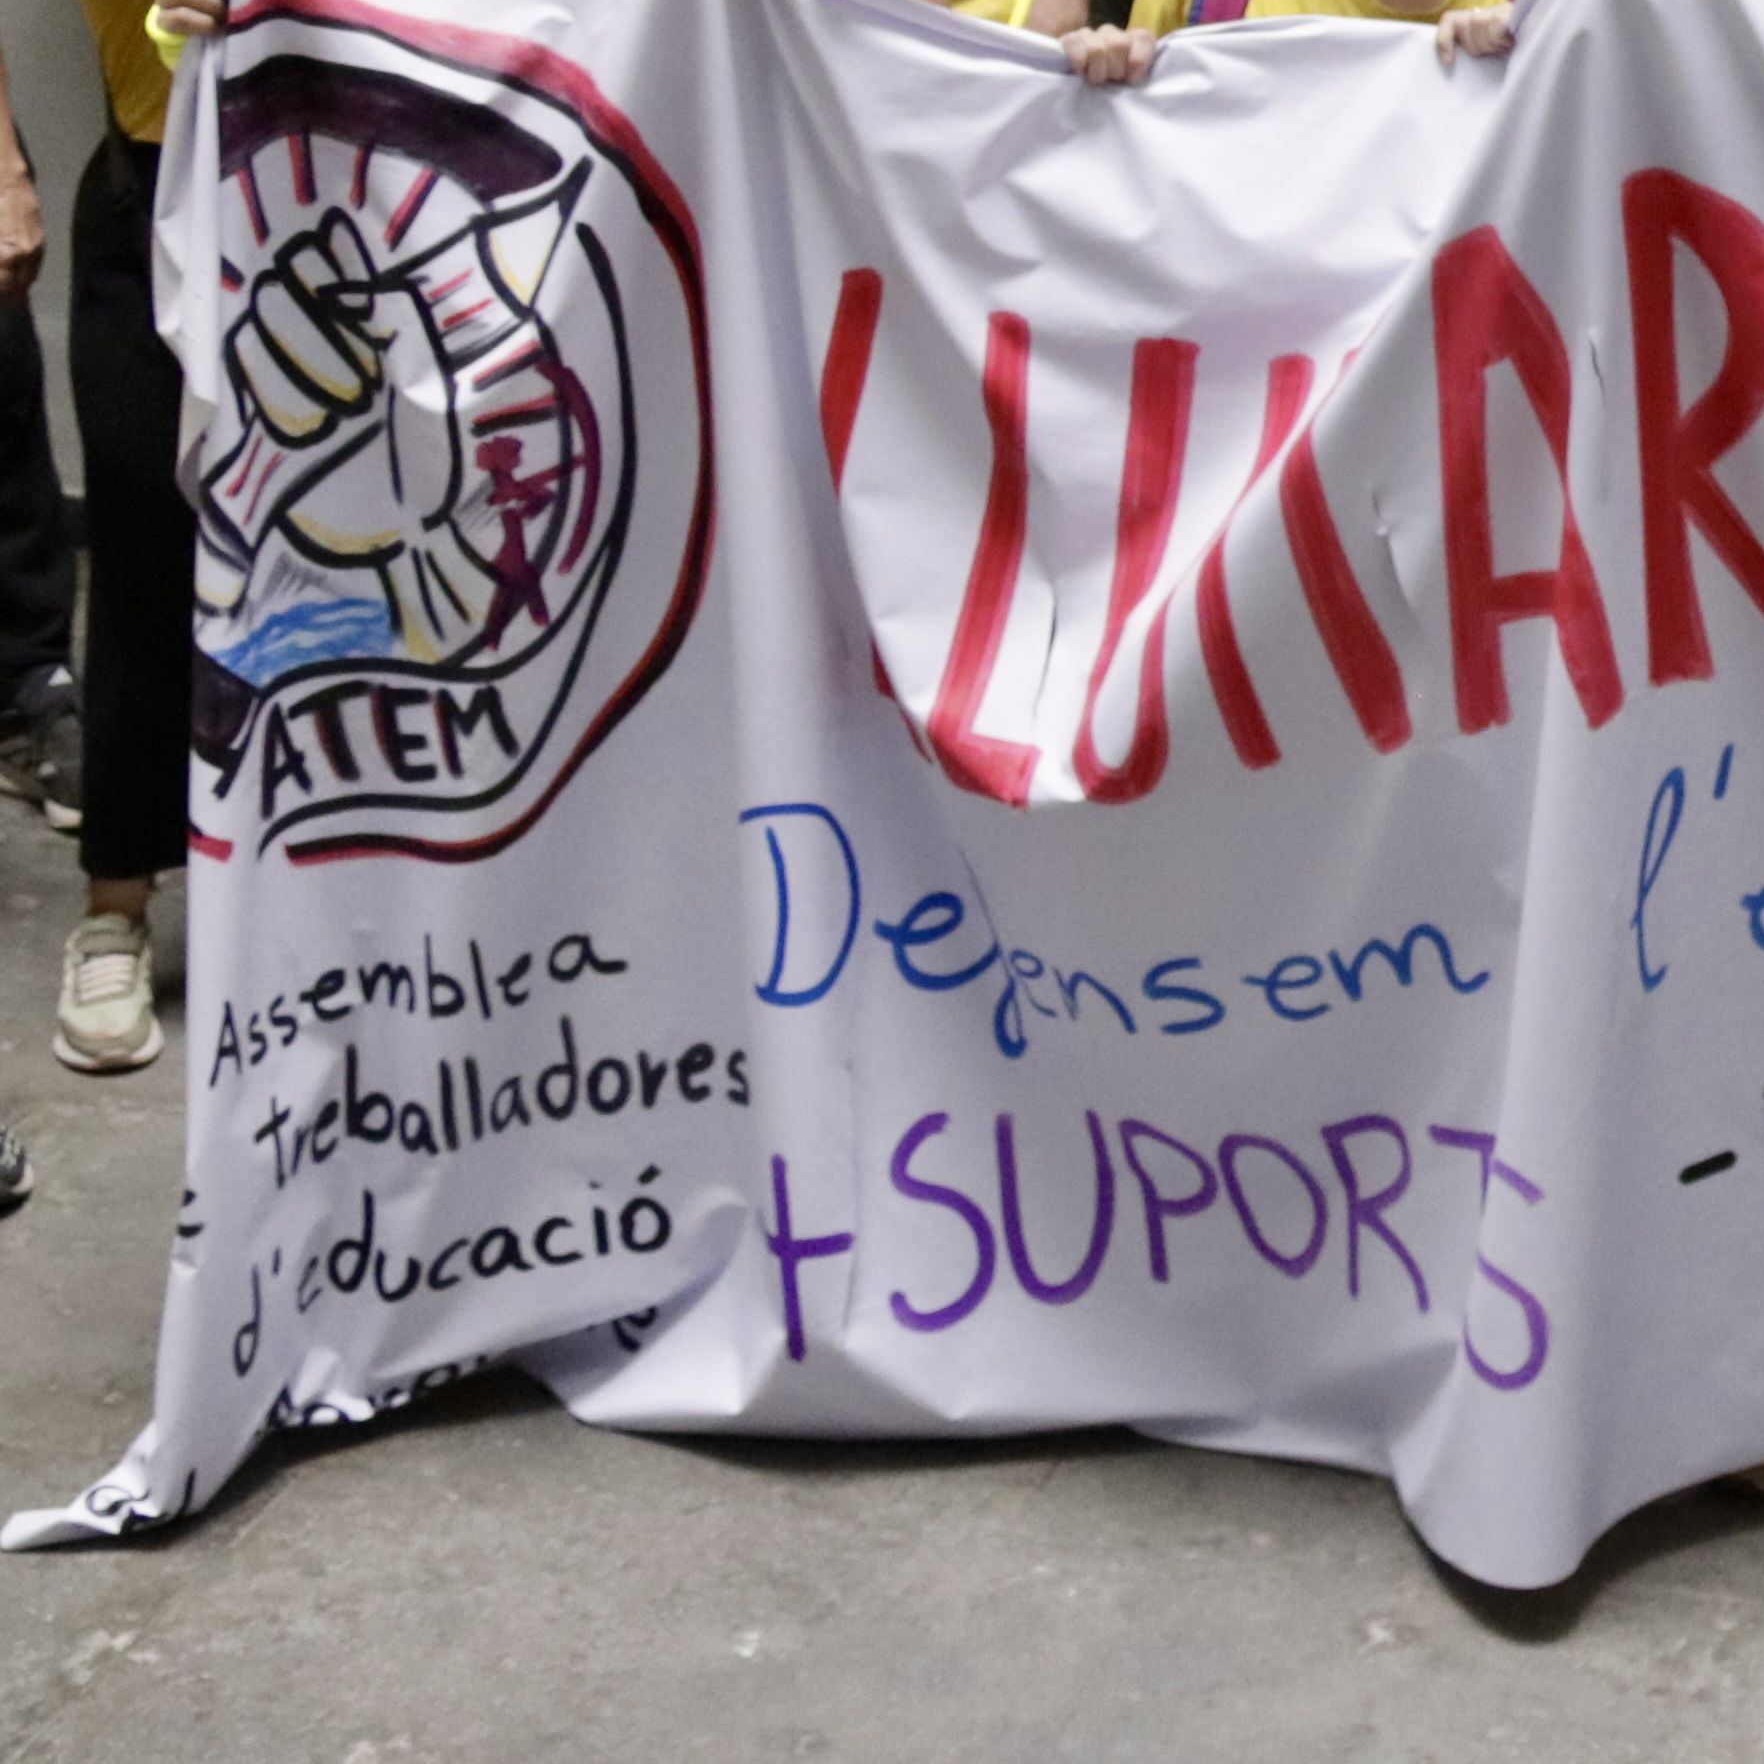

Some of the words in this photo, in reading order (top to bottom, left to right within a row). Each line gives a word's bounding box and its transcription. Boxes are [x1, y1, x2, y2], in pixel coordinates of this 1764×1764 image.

[260, 683, 521, 819] ATEM
[208, 932, 628, 1087] Assemblea
[253, 1015, 752, 1190] treballadores
[232, 1164, 673, 1379] d'educació
